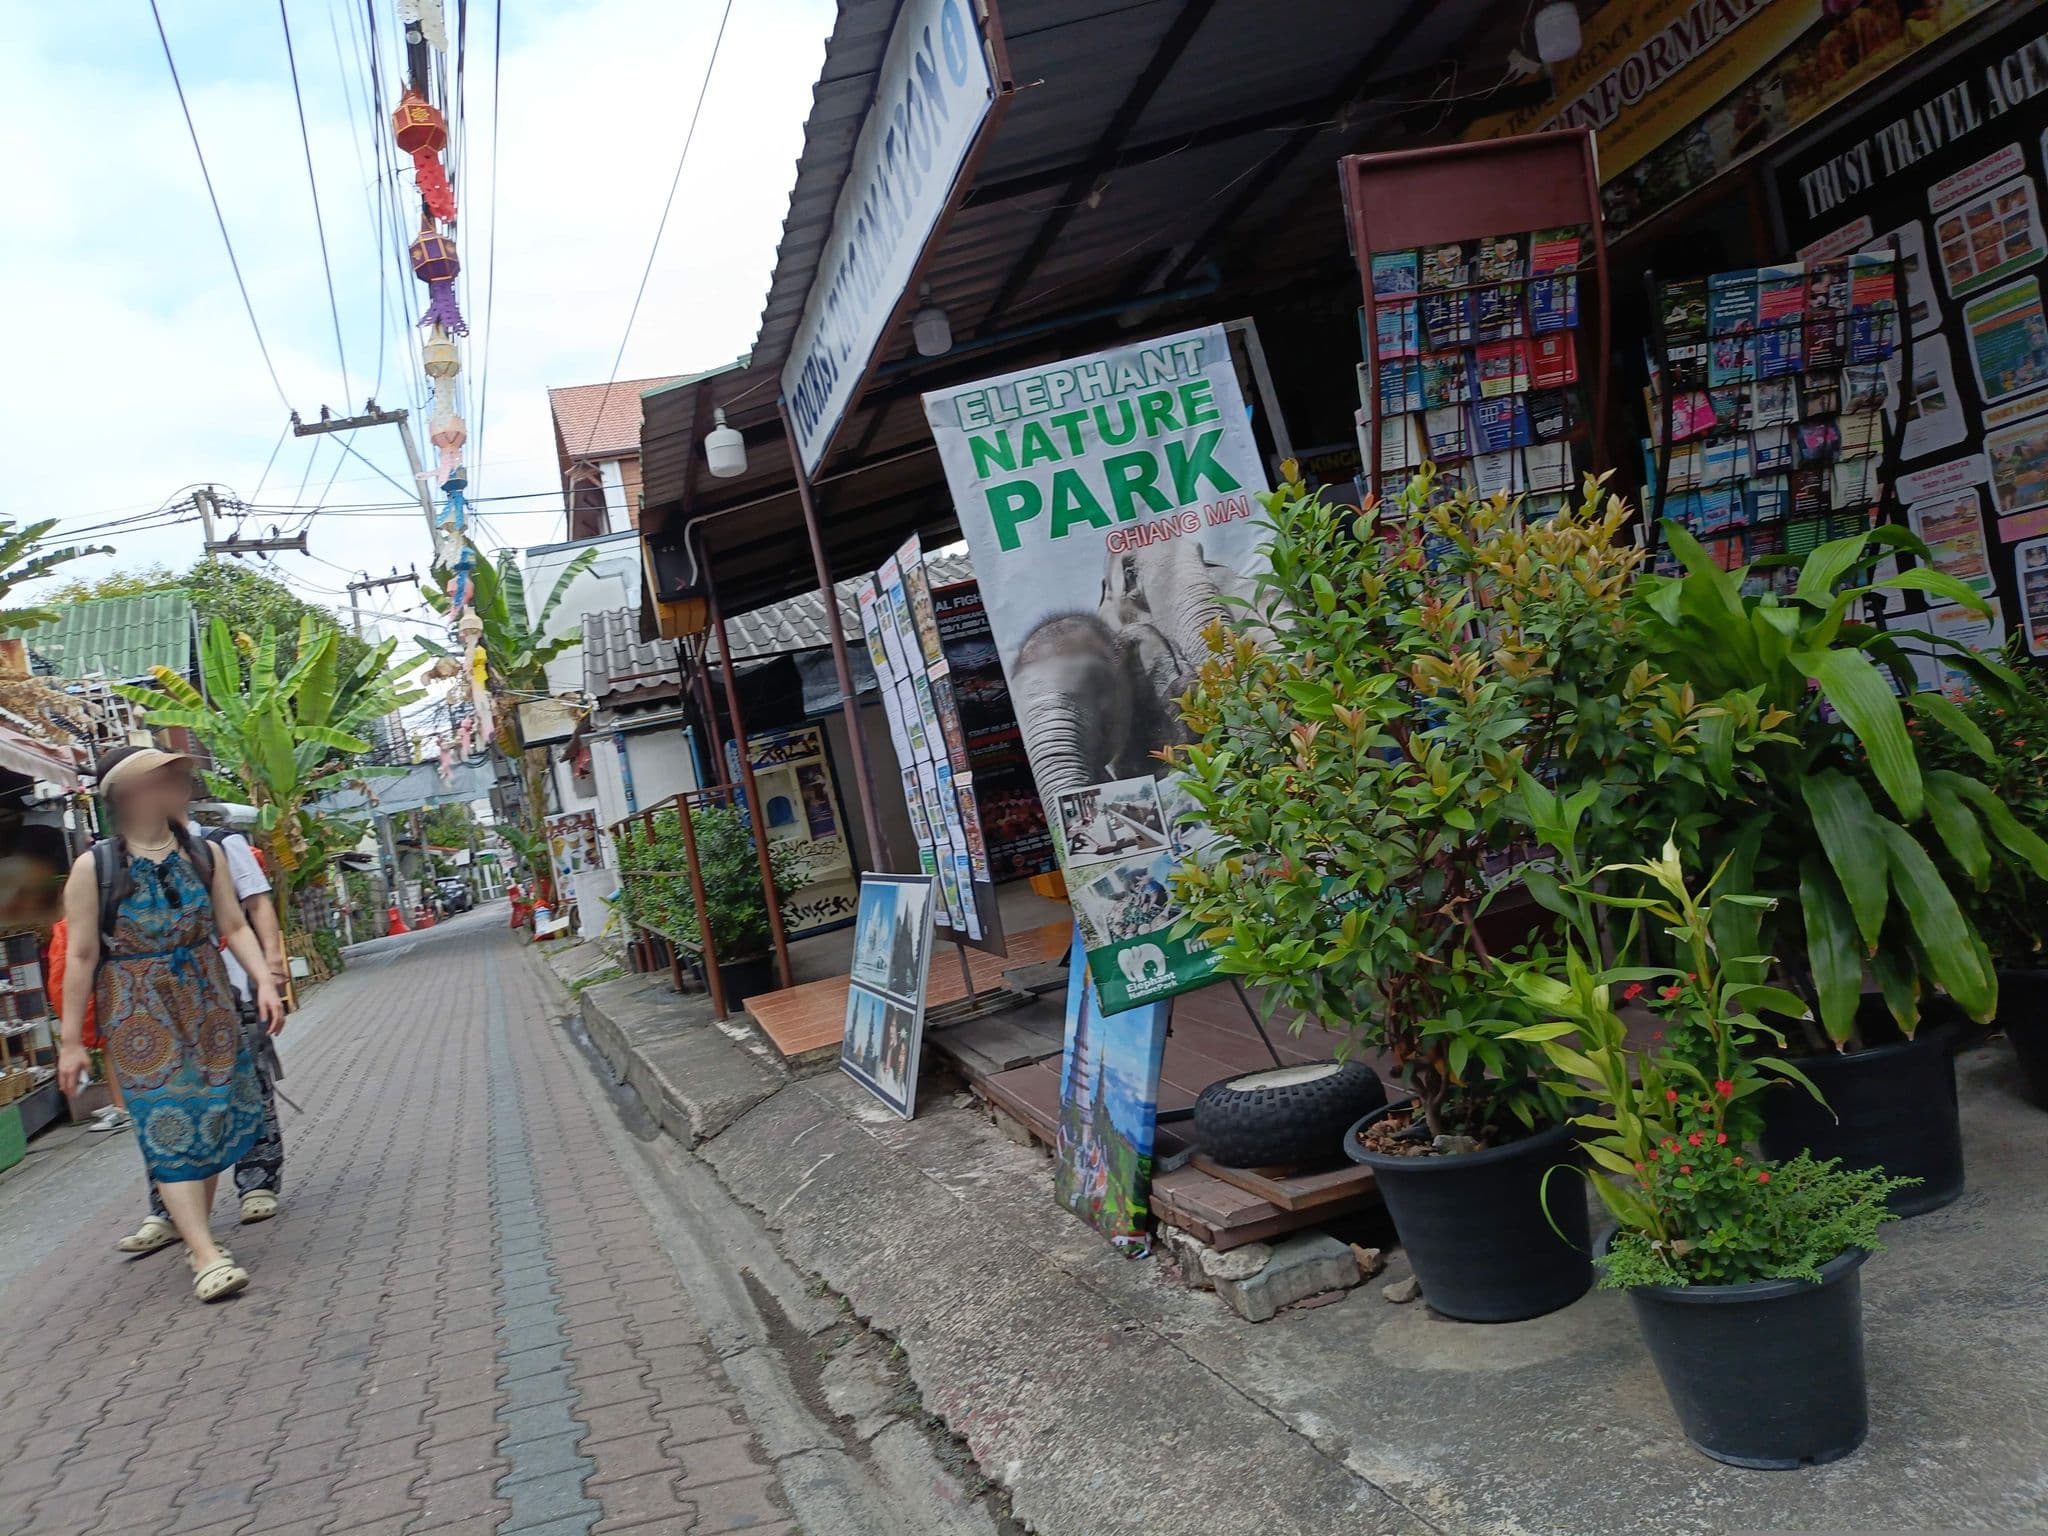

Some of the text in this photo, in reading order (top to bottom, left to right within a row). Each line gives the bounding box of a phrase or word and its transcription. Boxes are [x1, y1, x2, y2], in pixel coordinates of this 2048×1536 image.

[1799, 138, 1875, 220] TRUST
[1875, 80, 1983, 177] TRAVEL
[792, 25, 950, 448] TOURIST INFORMATION
[954, 338, 1204, 432] ELEPHANT
[967, 378, 1221, 480] NATURE
[984, 427, 1243, 553] PARK
[1105, 495, 1250, 554] CHIANG MAI
[935, 594, 983, 612] AL FIGH
[1125, 971, 1176, 993] Elephant
